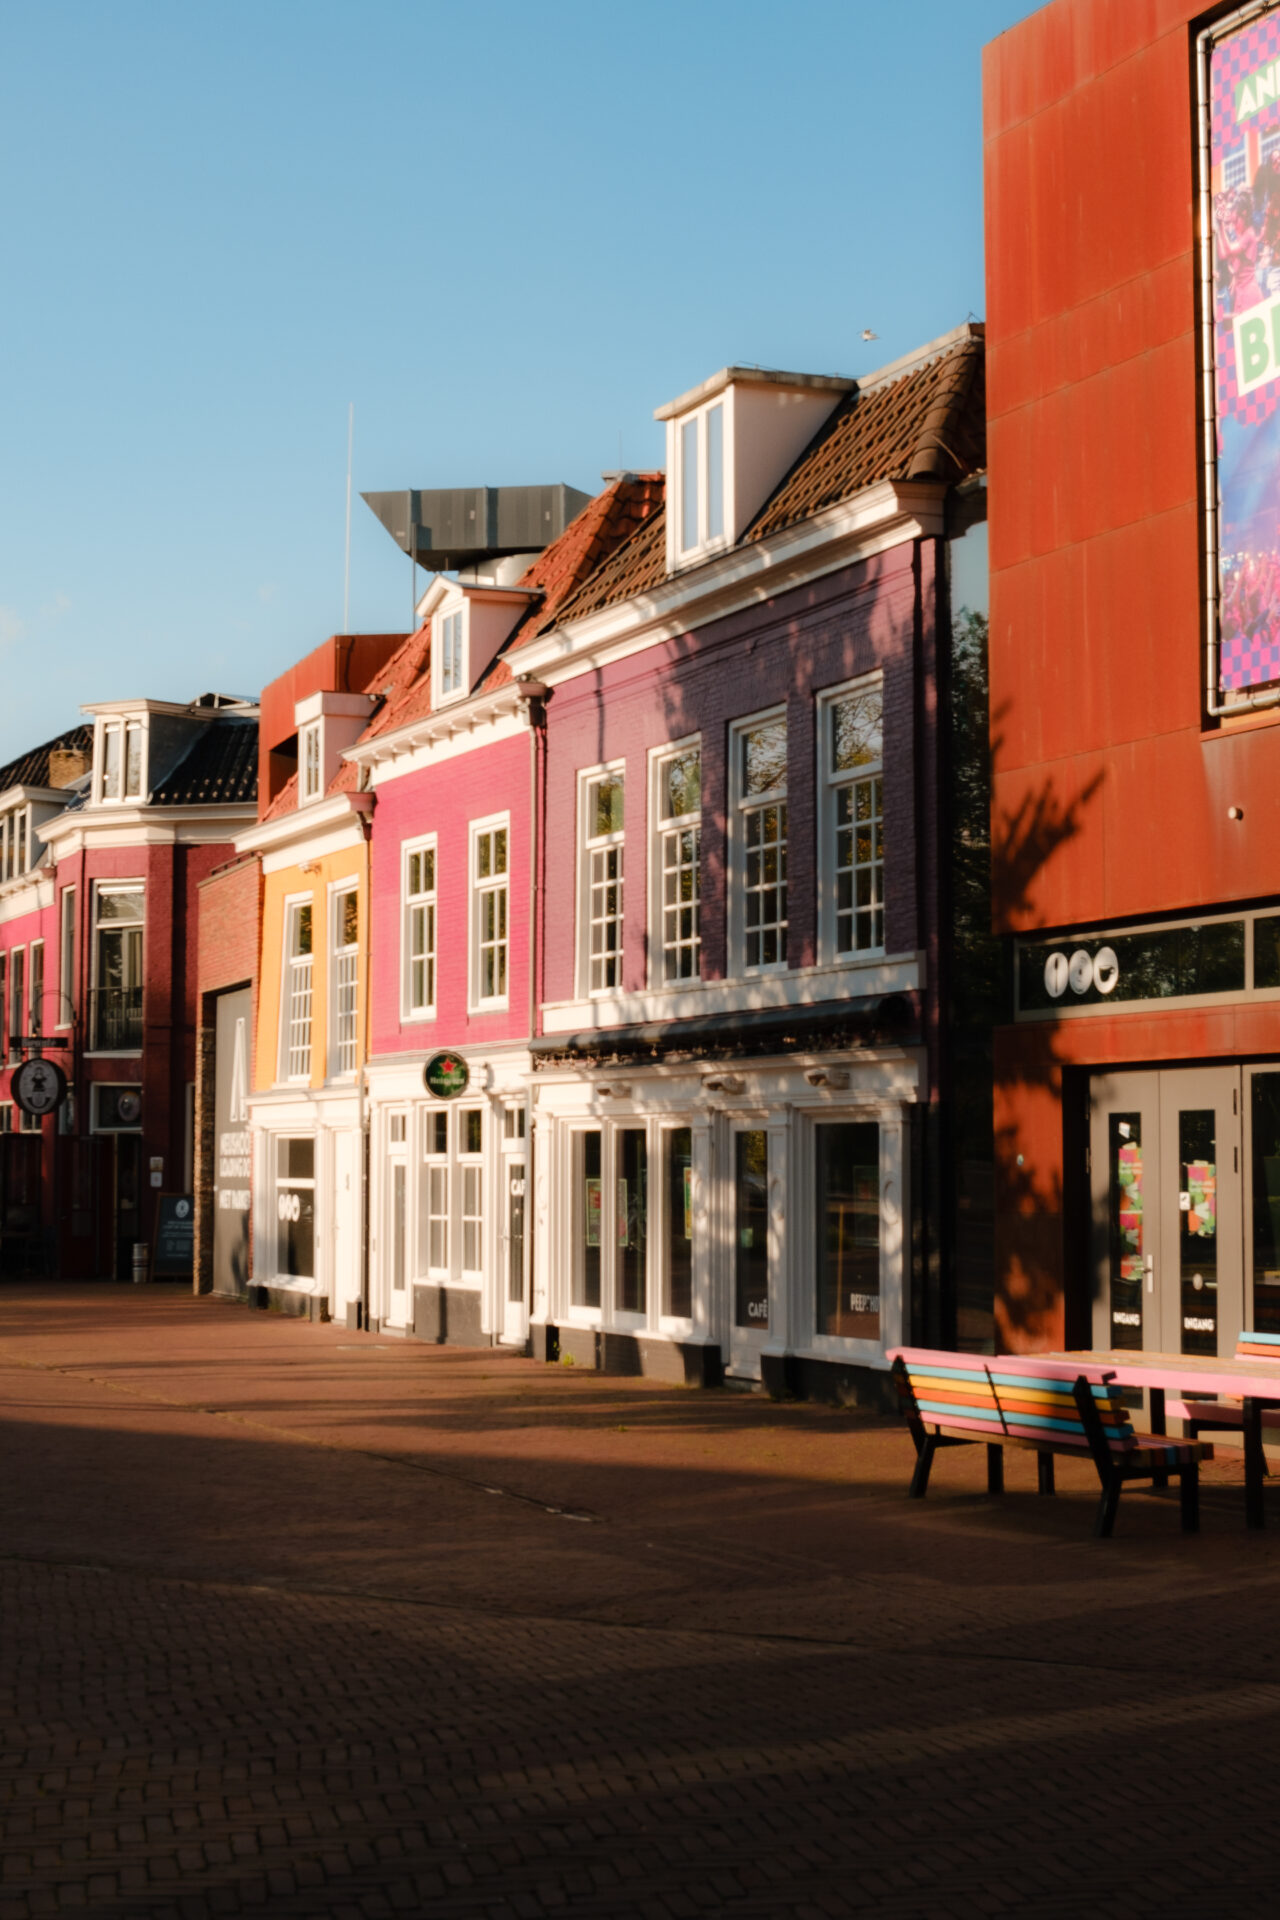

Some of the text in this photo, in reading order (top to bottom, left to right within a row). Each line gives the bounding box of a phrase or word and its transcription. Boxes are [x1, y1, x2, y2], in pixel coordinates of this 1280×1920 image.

[1237, 59, 1280, 121] AN
[748, 1298, 768, 1318] CAFÉ
[1113, 1311, 1140, 1326] INGANG
[1184, 1316, 1214, 1332] INGANG
